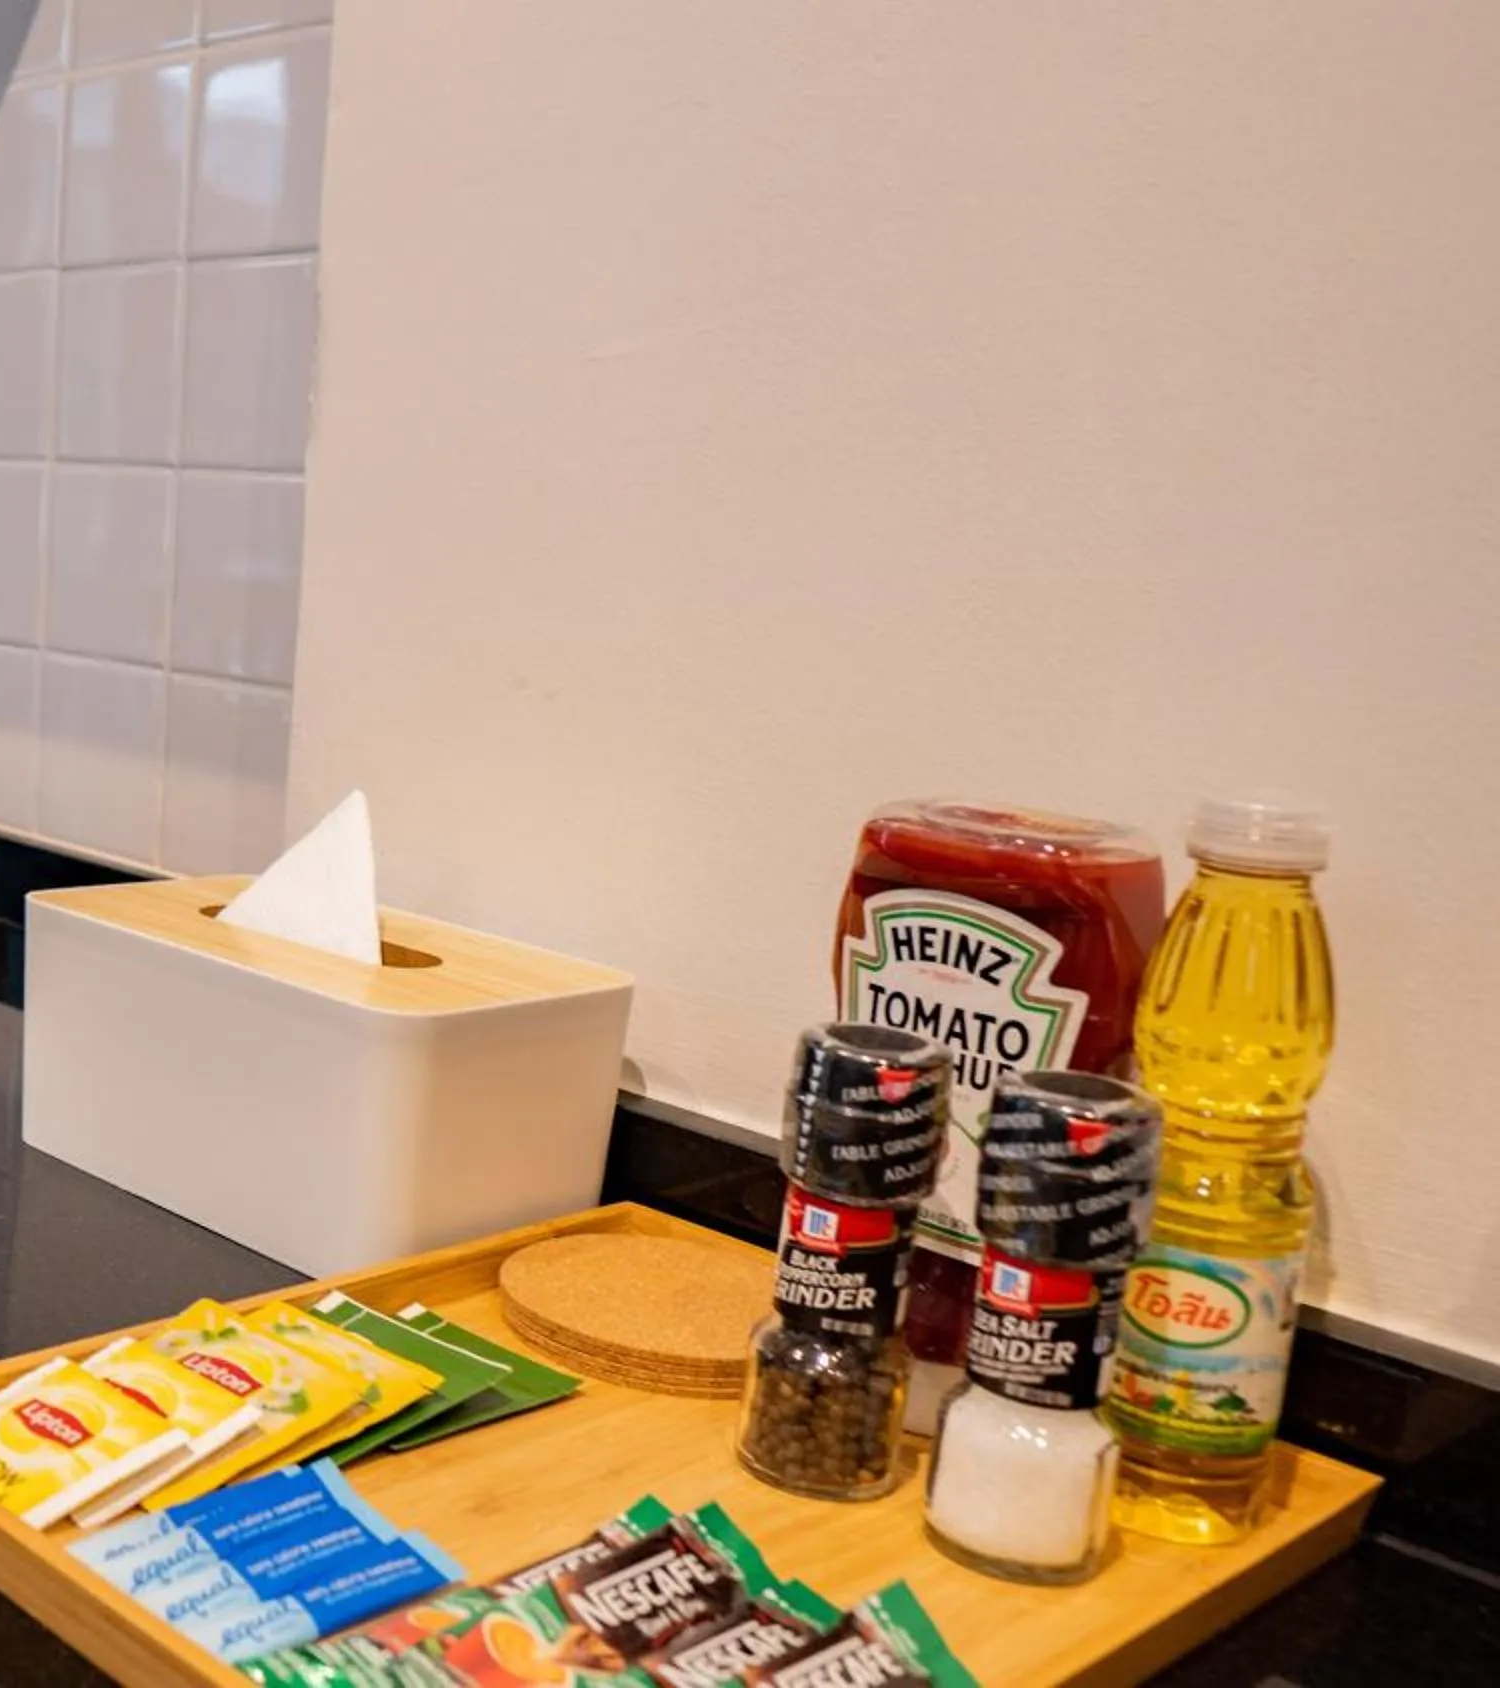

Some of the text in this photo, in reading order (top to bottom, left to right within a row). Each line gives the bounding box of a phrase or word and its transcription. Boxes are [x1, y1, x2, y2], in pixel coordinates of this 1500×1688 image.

[891, 925, 1013, 986] HEINZ
[868, 983, 1029, 1061] TOMATO
[790, 1249, 839, 1271] BLACK
[775, 1280, 877, 1310] RINDER
[968, 1328, 1078, 1365] RINDER
[1001, 1315, 1059, 1339] SALT
[183, 1355, 252, 1395] Lipton
[21, 1401, 83, 1445] Lipton
[129, 1529, 202, 1594] equal
[165, 1565, 235, 1621] equal
[219, 1599, 291, 1650] equal
